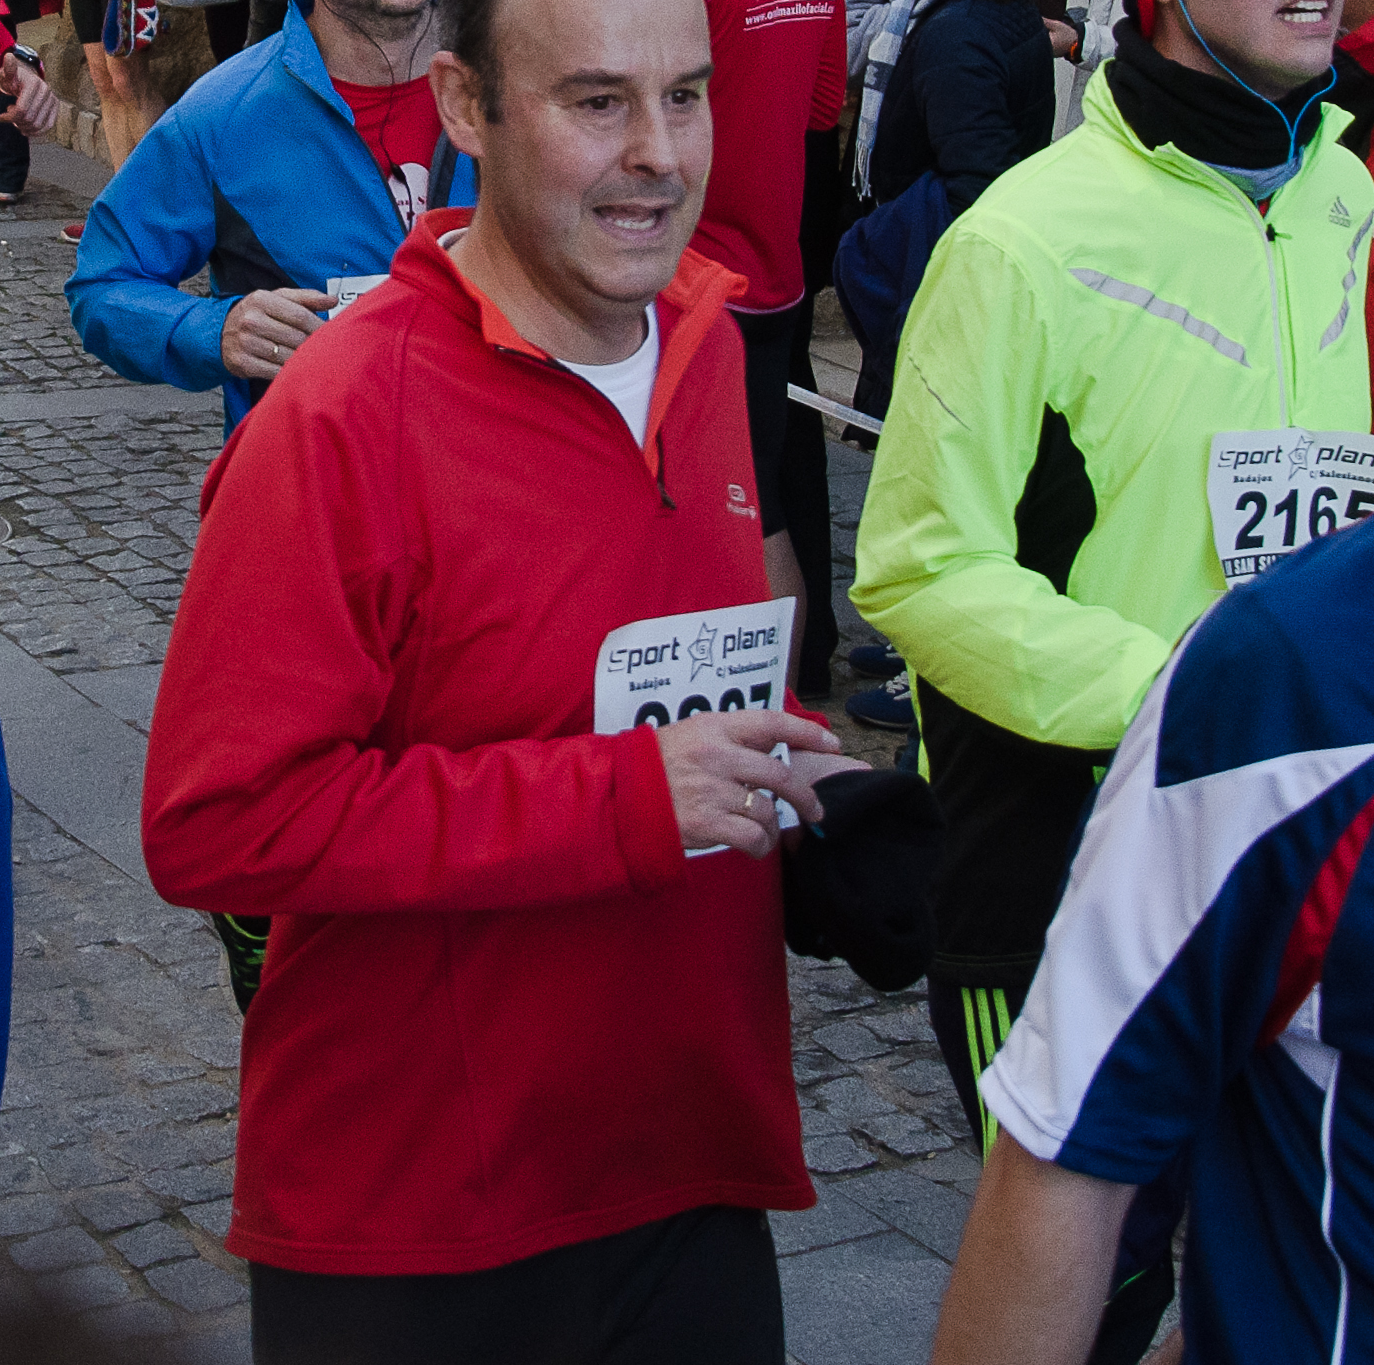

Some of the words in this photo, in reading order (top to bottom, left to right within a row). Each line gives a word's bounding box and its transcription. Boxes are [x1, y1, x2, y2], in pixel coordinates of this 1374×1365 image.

[1218, 445, 1283, 470] Sport
[1233, 475, 1273, 484] Badajoz
[1234, 557, 1255, 575] SAN
[607, 637, 680, 674] Sport
[629, 677, 671, 693] Badajoz
